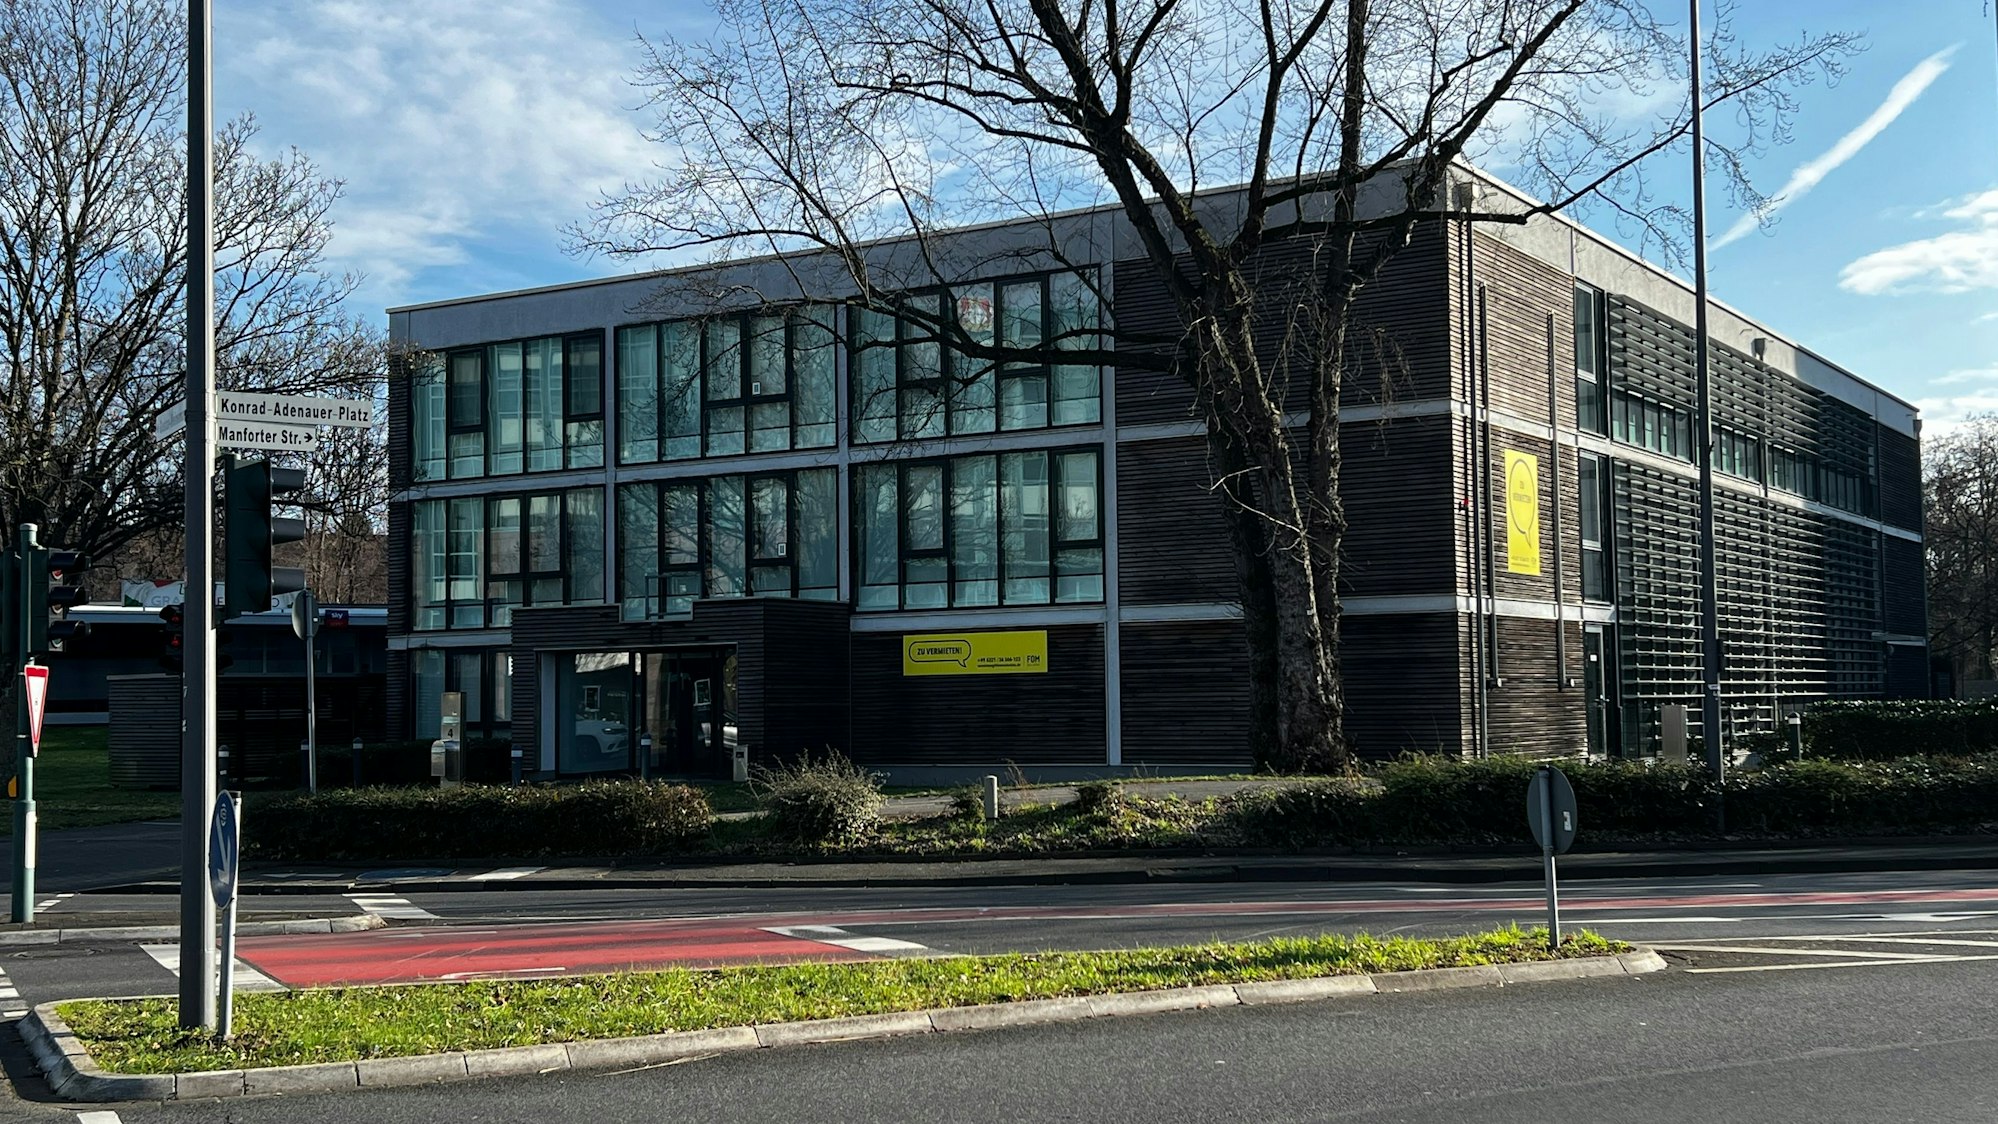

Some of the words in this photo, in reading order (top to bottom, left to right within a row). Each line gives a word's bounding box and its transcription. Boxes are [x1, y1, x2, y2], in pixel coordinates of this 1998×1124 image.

[221, 398, 369, 422] Konrad-Adenauer-Platz
[219, 426, 277, 444] Manforter
[281, 428, 302, 445] Str.
[331, 612, 343, 620] sky
[917, 647, 926, 656] ZU
[1027, 655, 1040, 663] FOM
[448, 728, 454, 738] 4
